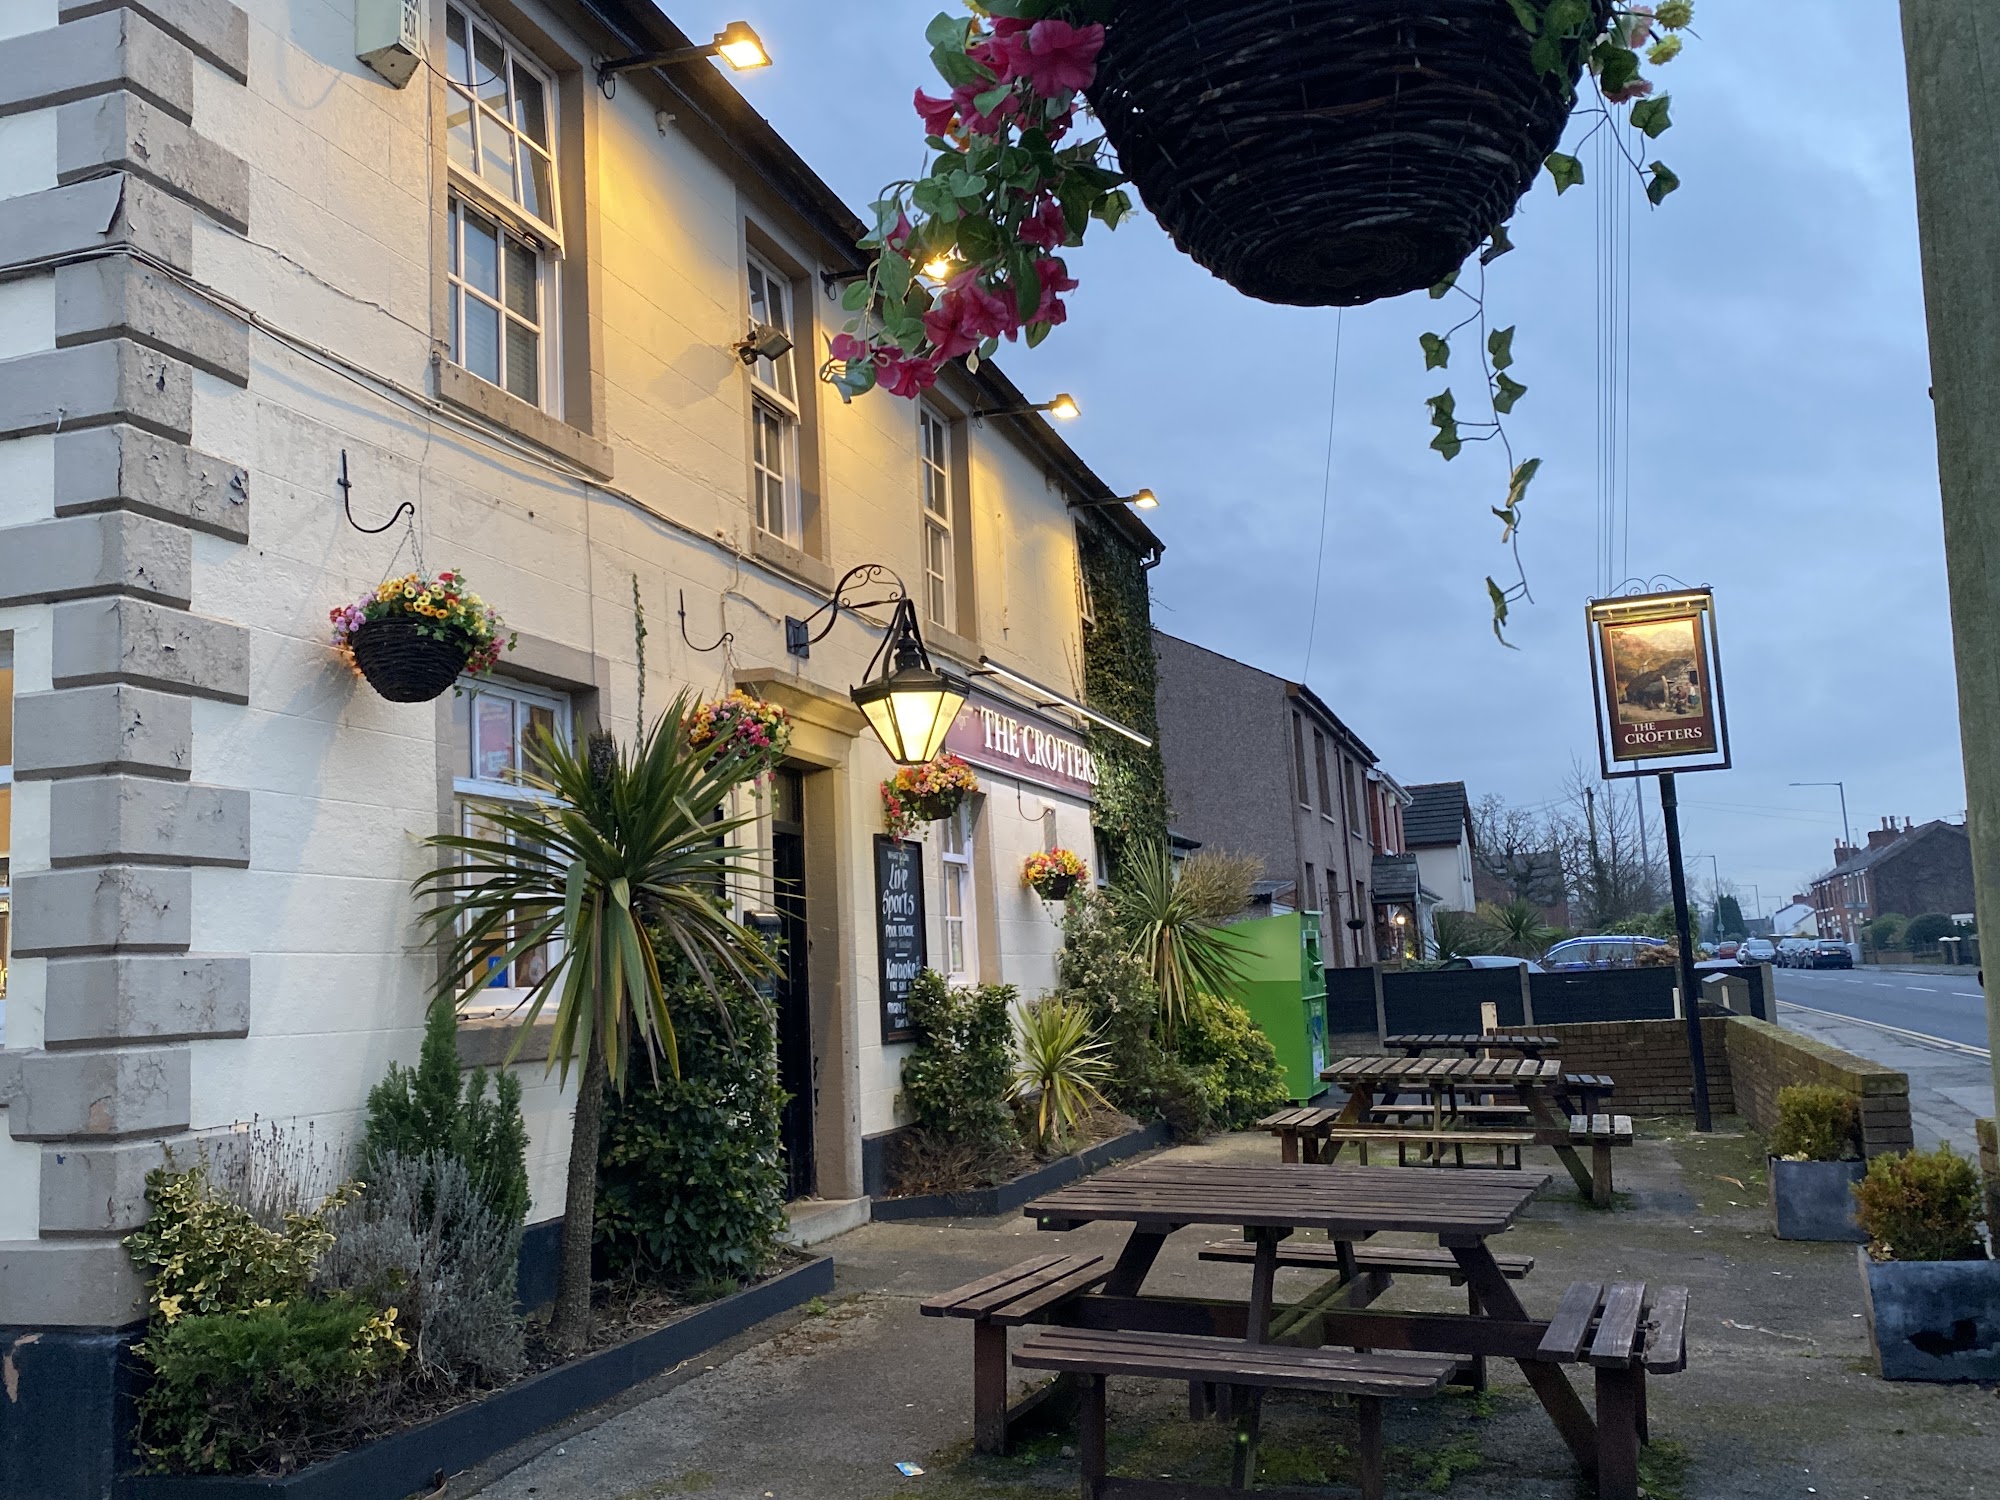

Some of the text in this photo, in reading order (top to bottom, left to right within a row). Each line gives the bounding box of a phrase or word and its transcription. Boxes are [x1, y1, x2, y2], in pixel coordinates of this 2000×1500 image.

[1624, 726, 1703, 745] CROFTERS
[1632, 722, 1656, 732] THE
[980, 705, 1099, 786] THE CROFTERS
[888, 863, 908, 891] Live
[882, 889, 915, 920] Sports
[885, 924, 898, 938] POOL
[886, 958, 916, 979] Karaoke
